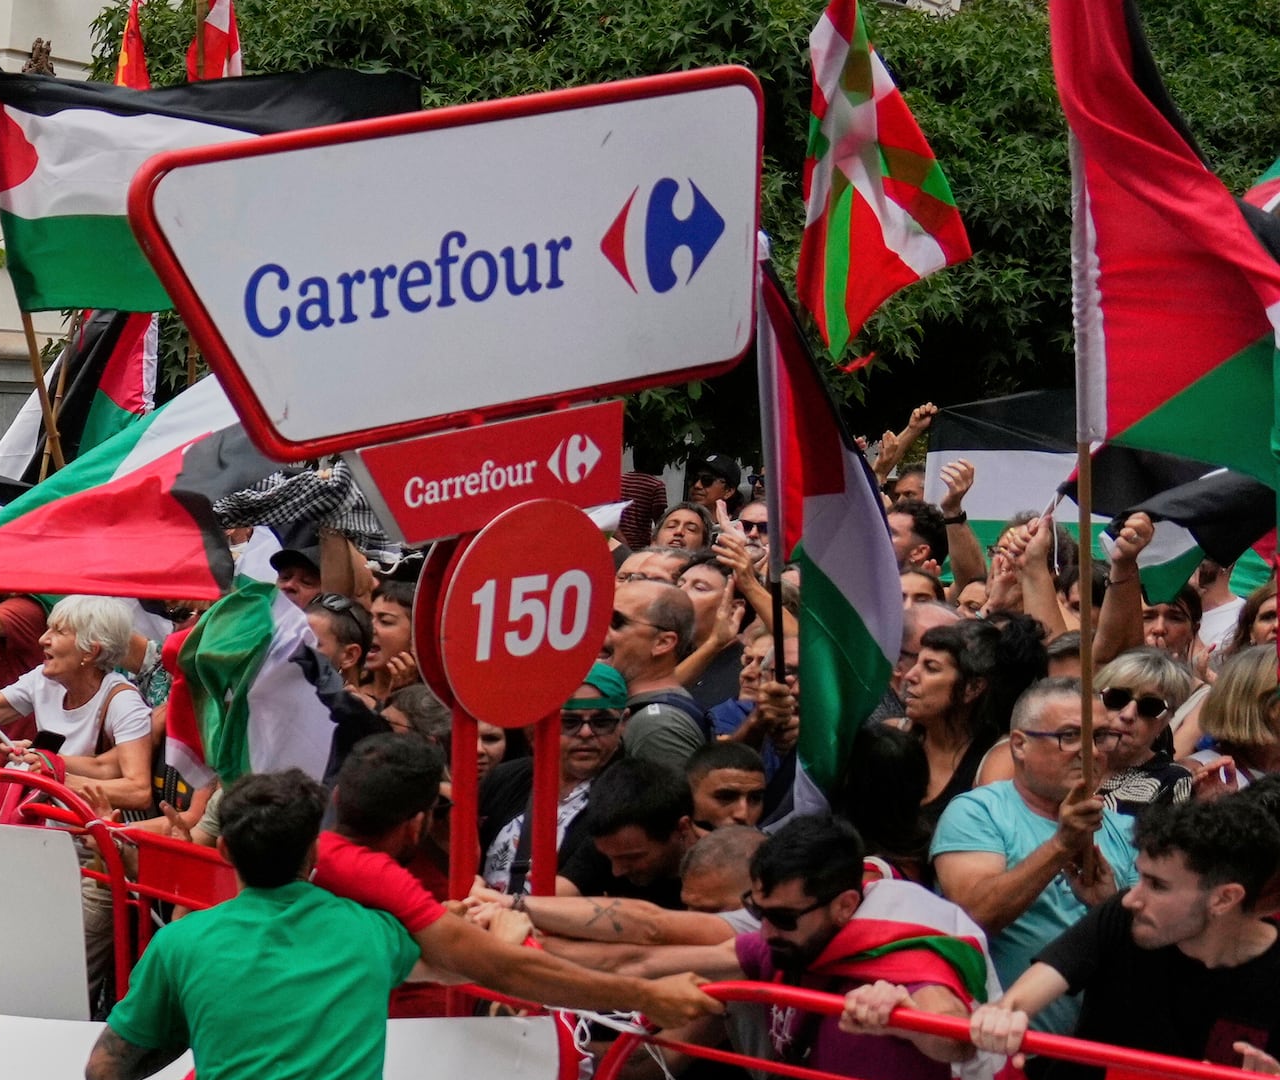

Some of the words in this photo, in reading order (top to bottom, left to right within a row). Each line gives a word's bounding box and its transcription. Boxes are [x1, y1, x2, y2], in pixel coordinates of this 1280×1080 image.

[243, 230, 573, 339] Carrefour
[403, 458, 539, 509] Carrefour
[471, 569, 593, 663] 150
